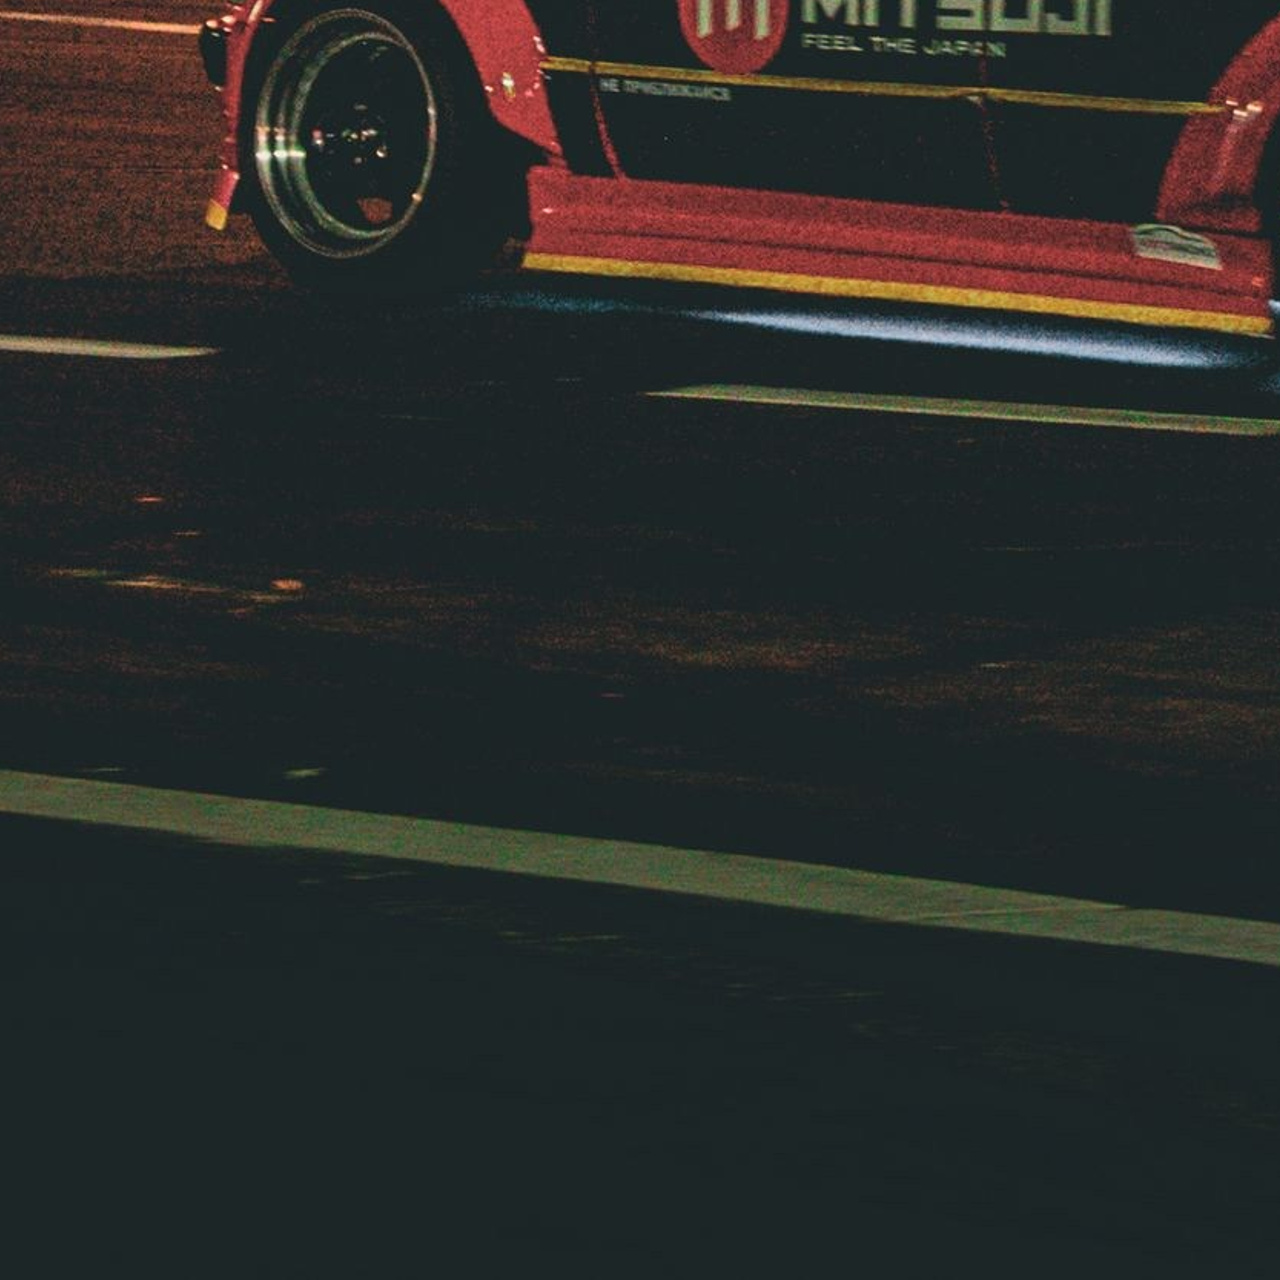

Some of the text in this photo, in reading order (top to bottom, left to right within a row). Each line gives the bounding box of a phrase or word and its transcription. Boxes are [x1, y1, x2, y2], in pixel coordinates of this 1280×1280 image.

[802, 33, 1008, 58] FEEL THE JAPAN
